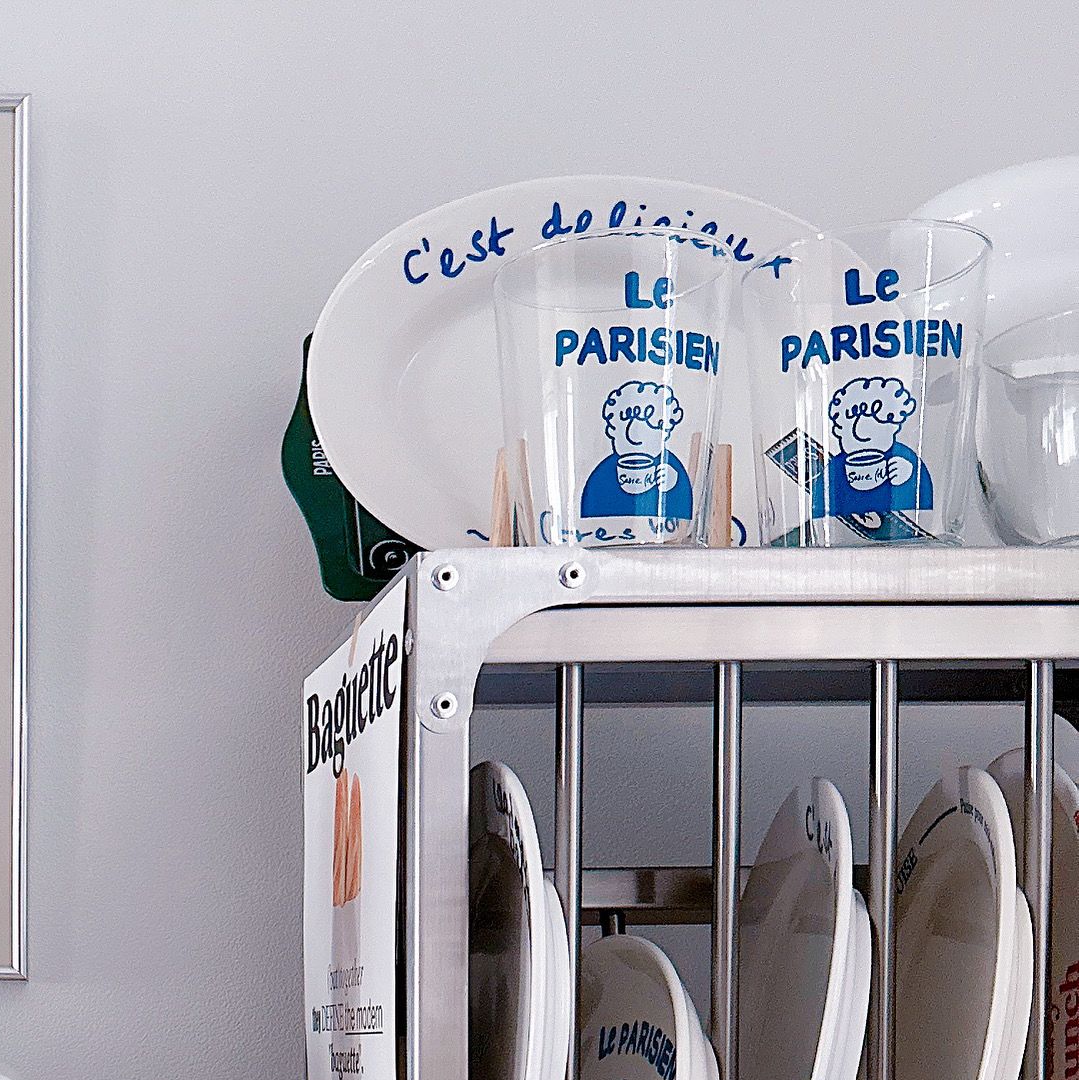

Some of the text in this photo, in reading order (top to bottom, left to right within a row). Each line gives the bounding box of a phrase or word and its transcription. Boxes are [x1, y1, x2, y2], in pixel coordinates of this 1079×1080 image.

[403, 217, 514, 284] C'est
[625, 271, 674, 309] Le
[845, 268, 900, 305] Le
[555, 326, 720, 376] PARISIEN
[781, 319, 963, 373] PARISIEN
[306, 629, 398, 779] Baguette
[598, 1026, 617, 1061] Le
